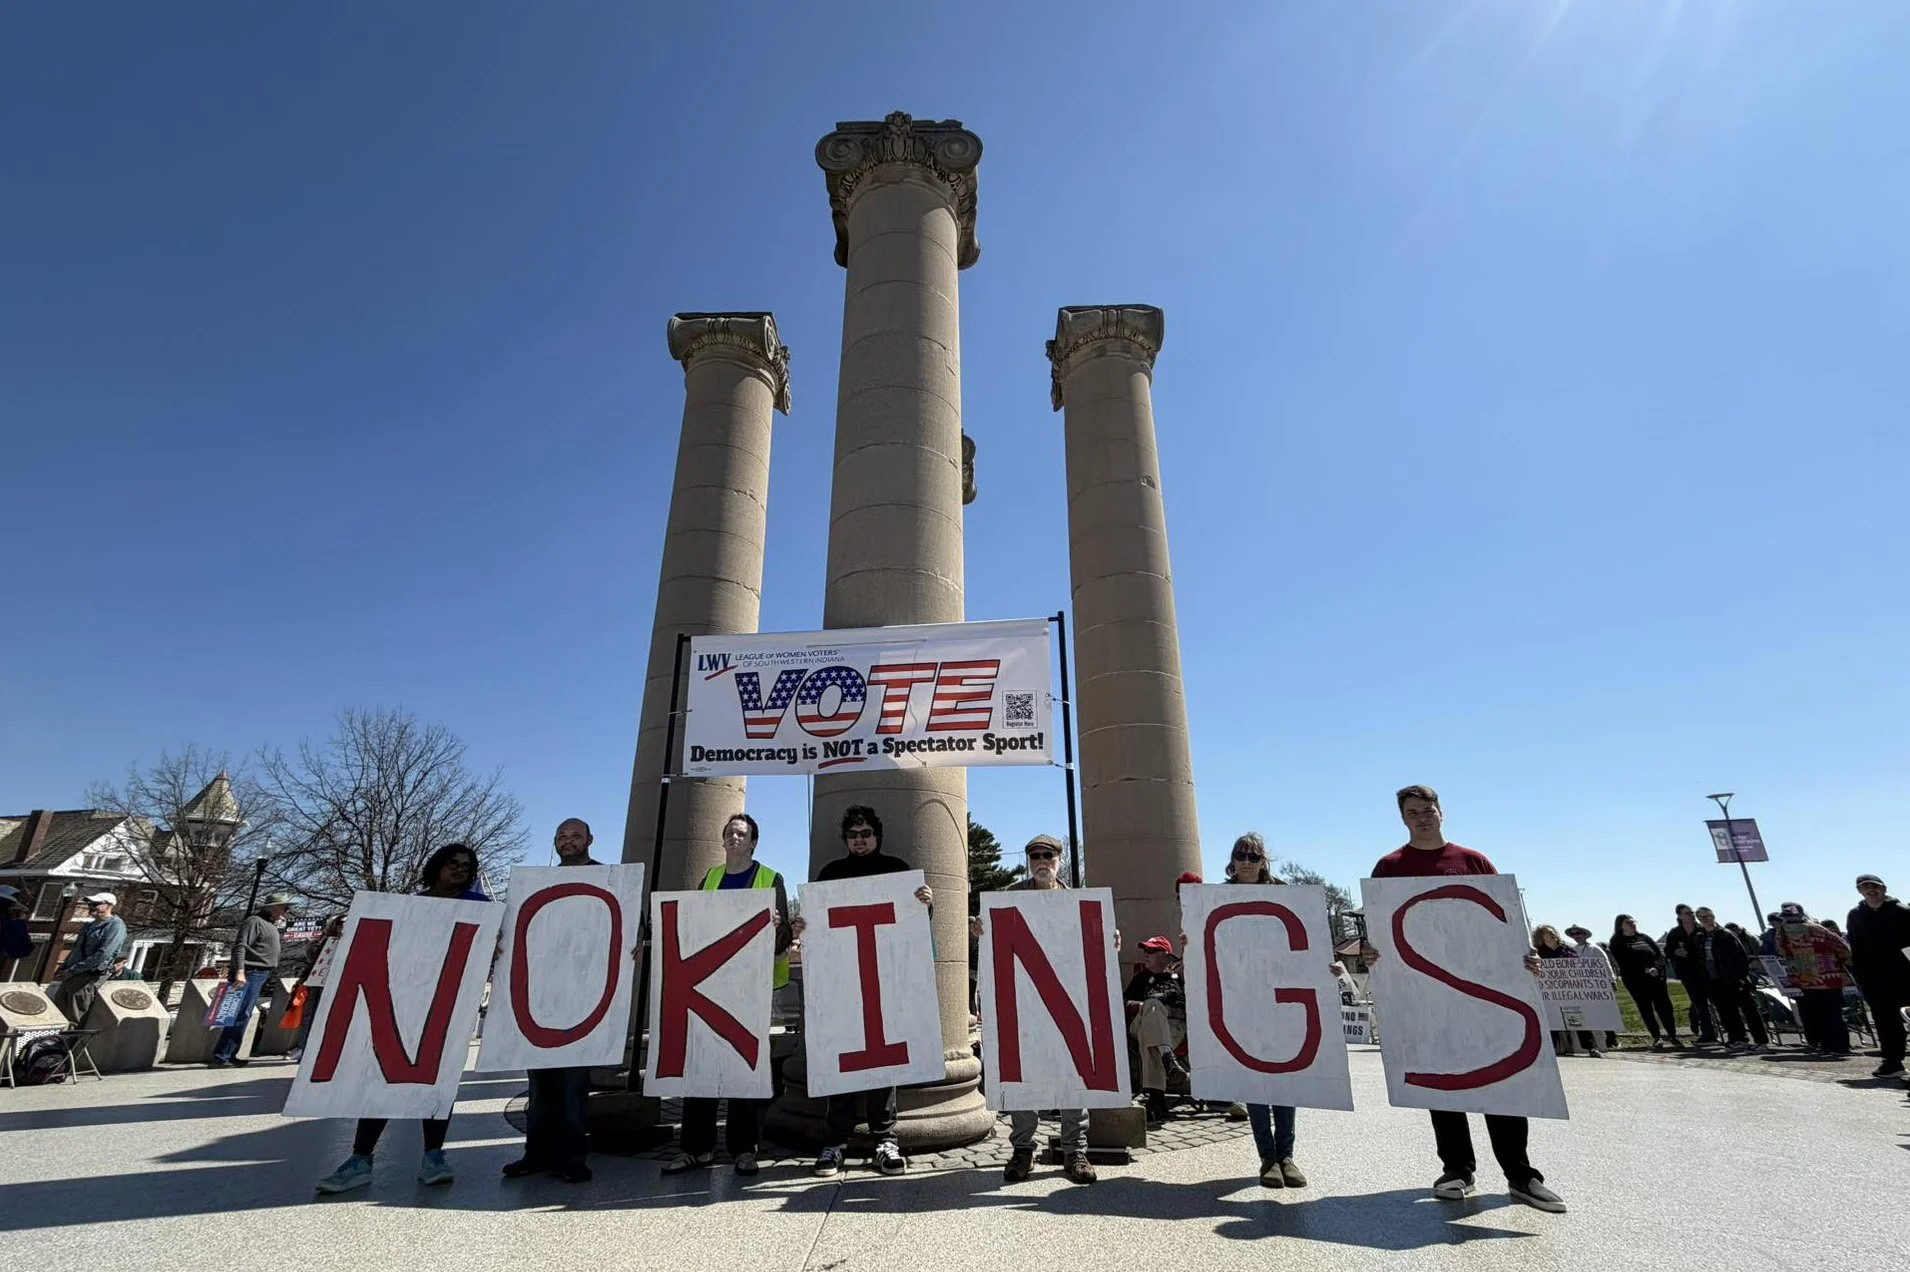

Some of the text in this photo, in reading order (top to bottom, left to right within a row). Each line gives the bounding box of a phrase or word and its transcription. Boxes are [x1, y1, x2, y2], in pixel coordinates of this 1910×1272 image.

[735, 652, 765, 661] LEAGUE
[775, 651, 807, 659] WOMEN
[698, 653, 731, 671] LWV
[754, 657, 814, 667] SOUTHWESTERN
[814, 656, 846, 664] INDIANA
[734, 659, 1001, 740] VOTE
[690, 732, 1044, 765] Democracy is NOT a Spectator Sport!
[1541, 959, 1555, 969] ALD
[1568, 968, 1606, 978] CHILDREN
[1544, 979, 1594, 989] SYCOPHANTS
[1594, 979, 1608, 989] TO
[1552, 991, 1584, 1001] ILLEGAL
[1343, 1024, 1364, 1036] INGS
